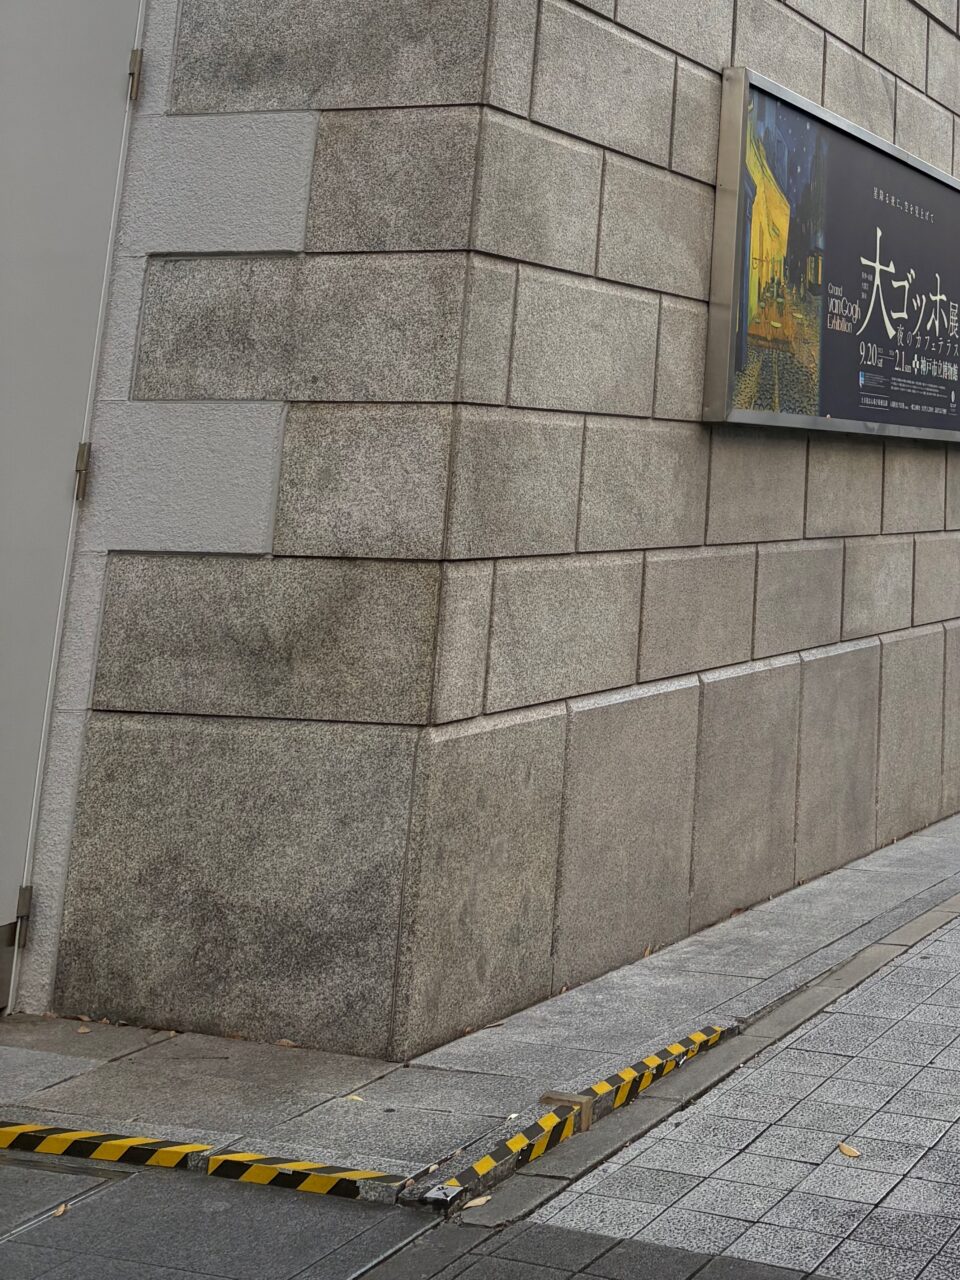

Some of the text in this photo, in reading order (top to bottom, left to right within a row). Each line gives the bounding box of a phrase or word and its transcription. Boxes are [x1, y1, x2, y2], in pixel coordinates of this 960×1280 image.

[827, 313, 853, 334] Exhibition
[896, 323, 959, 357] 夜のカフェテラス
[859, 341, 877, 366] 9.20
